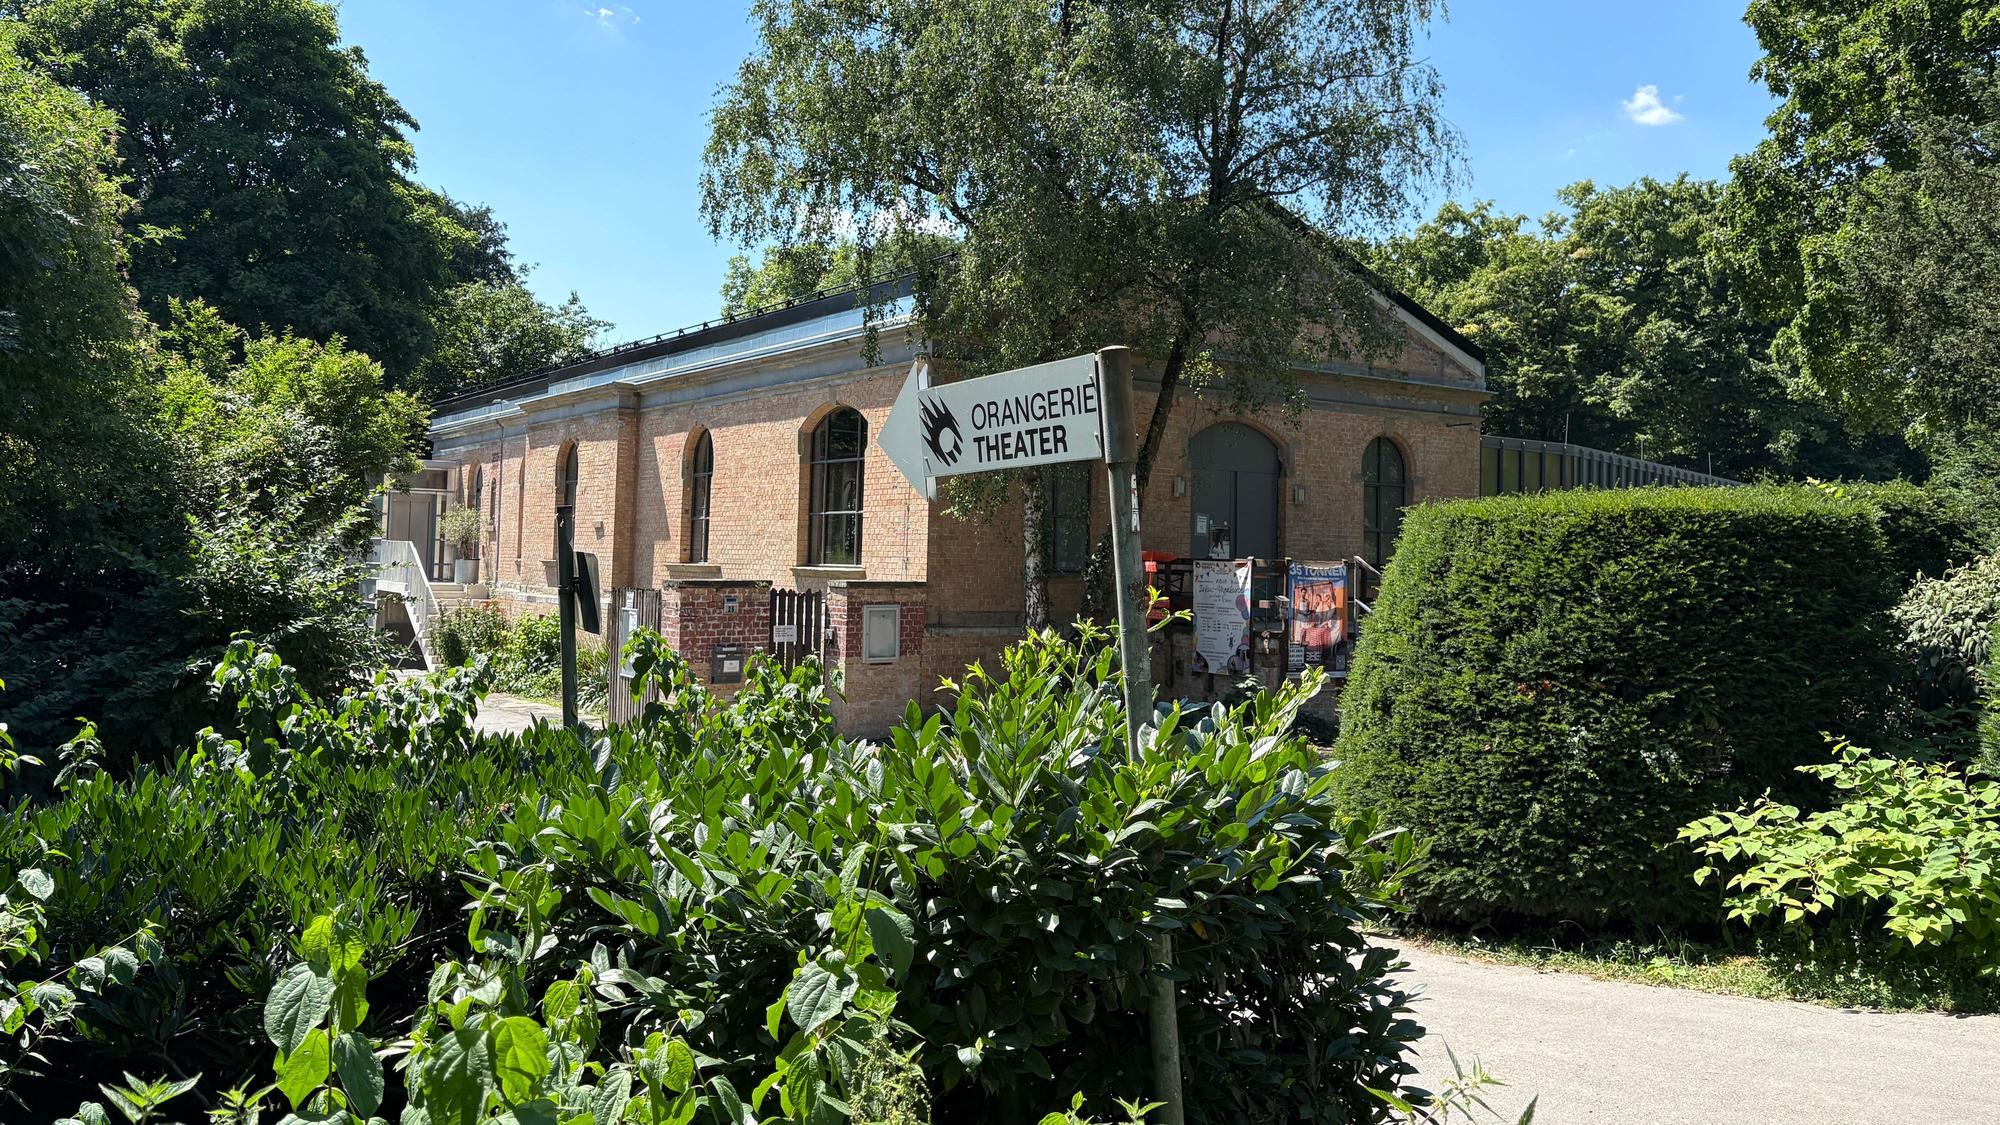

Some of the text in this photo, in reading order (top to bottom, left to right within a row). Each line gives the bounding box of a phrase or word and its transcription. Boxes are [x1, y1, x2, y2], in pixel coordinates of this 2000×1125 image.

[971, 383, 1097, 430] ORANGERIE
[973, 425, 1068, 463] THEATER
[1289, 563, 1302, 576] 35
